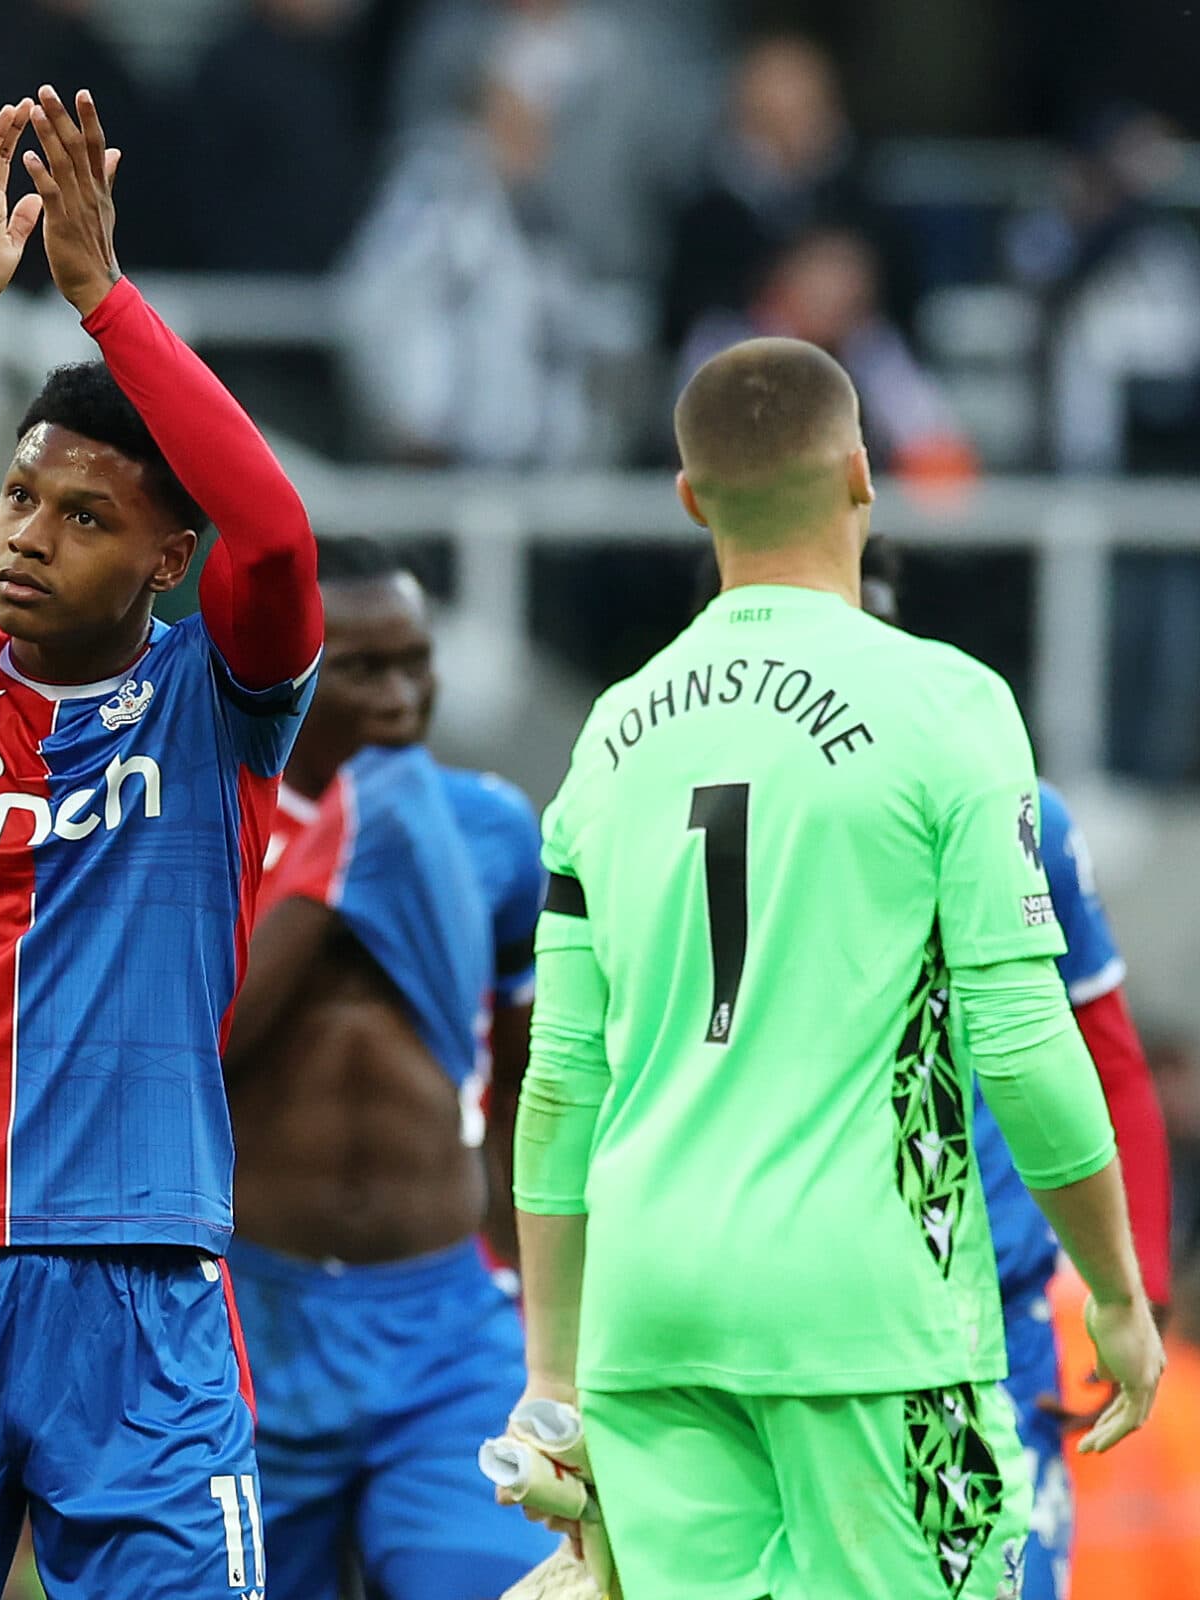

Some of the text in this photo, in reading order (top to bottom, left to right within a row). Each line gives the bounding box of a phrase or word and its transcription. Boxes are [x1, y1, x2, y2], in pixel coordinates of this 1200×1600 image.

[728, 608, 773, 624] EAGLES
[604, 658, 875, 773] JOHNSTONE
[686, 782, 750, 1043] 1
[209, 1473, 265, 1588] 11
